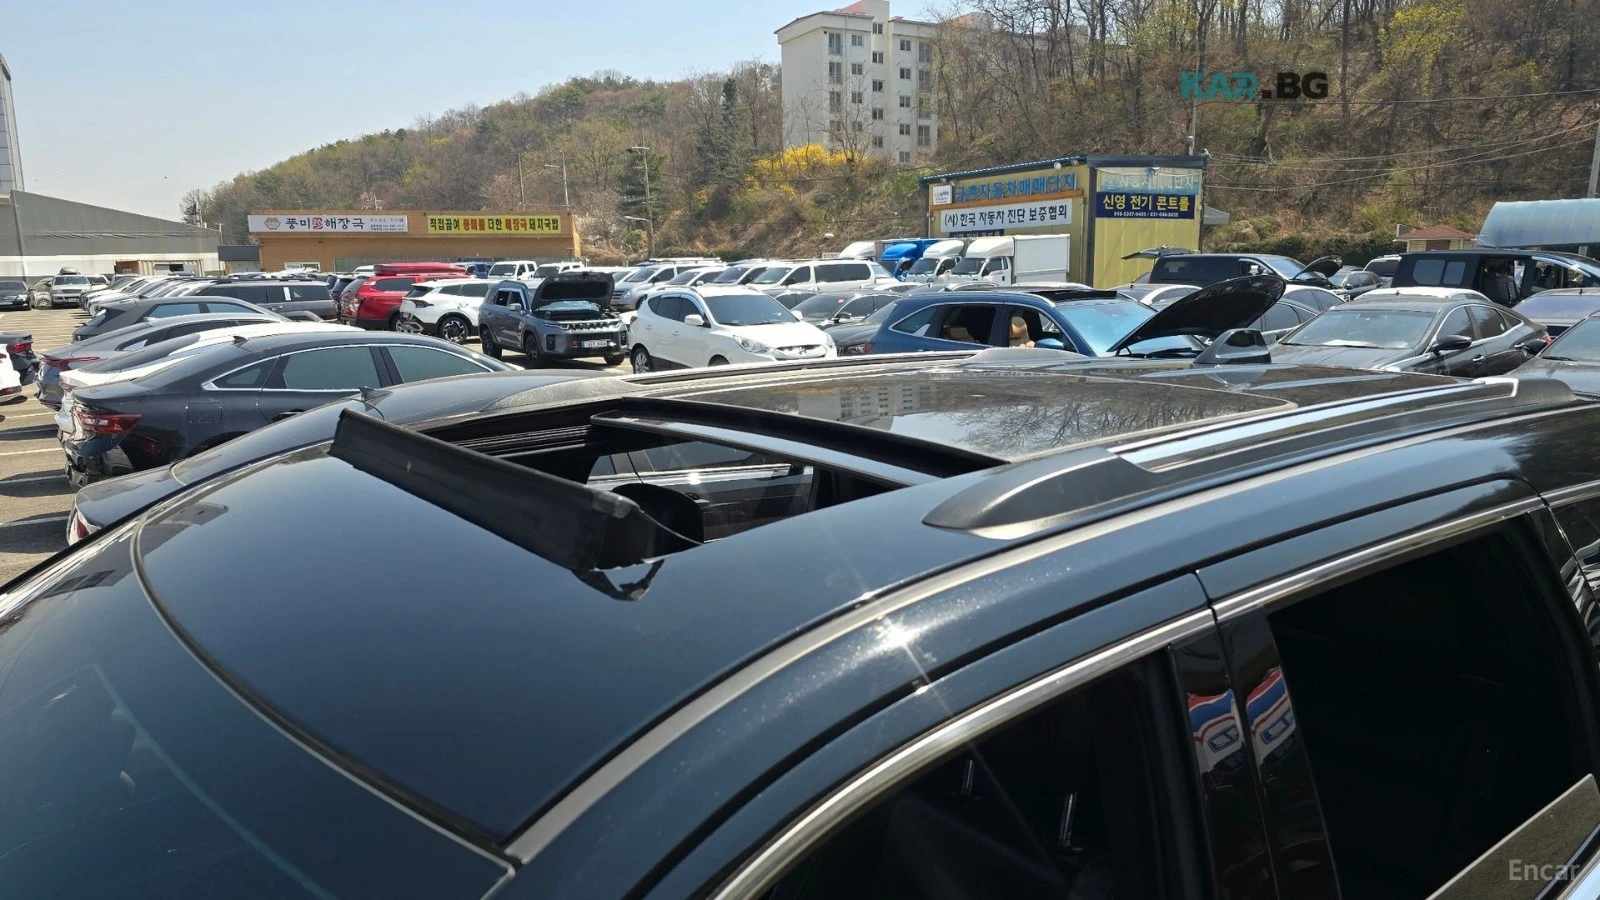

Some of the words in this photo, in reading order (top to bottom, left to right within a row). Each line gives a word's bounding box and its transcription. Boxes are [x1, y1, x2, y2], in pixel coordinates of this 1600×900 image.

[1103, 194, 1126, 210] 신영
[1130, 195, 1152, 210] 전기
[1156, 196, 1190, 212] 콘트롤
[979, 210, 1005, 225] 자동차
[1007, 207, 1026, 224] 진단
[1029, 204, 1067, 222] 보증협회
[505, 218, 527, 231] 해장국
[529, 218, 559, 231] 돼지국밥
